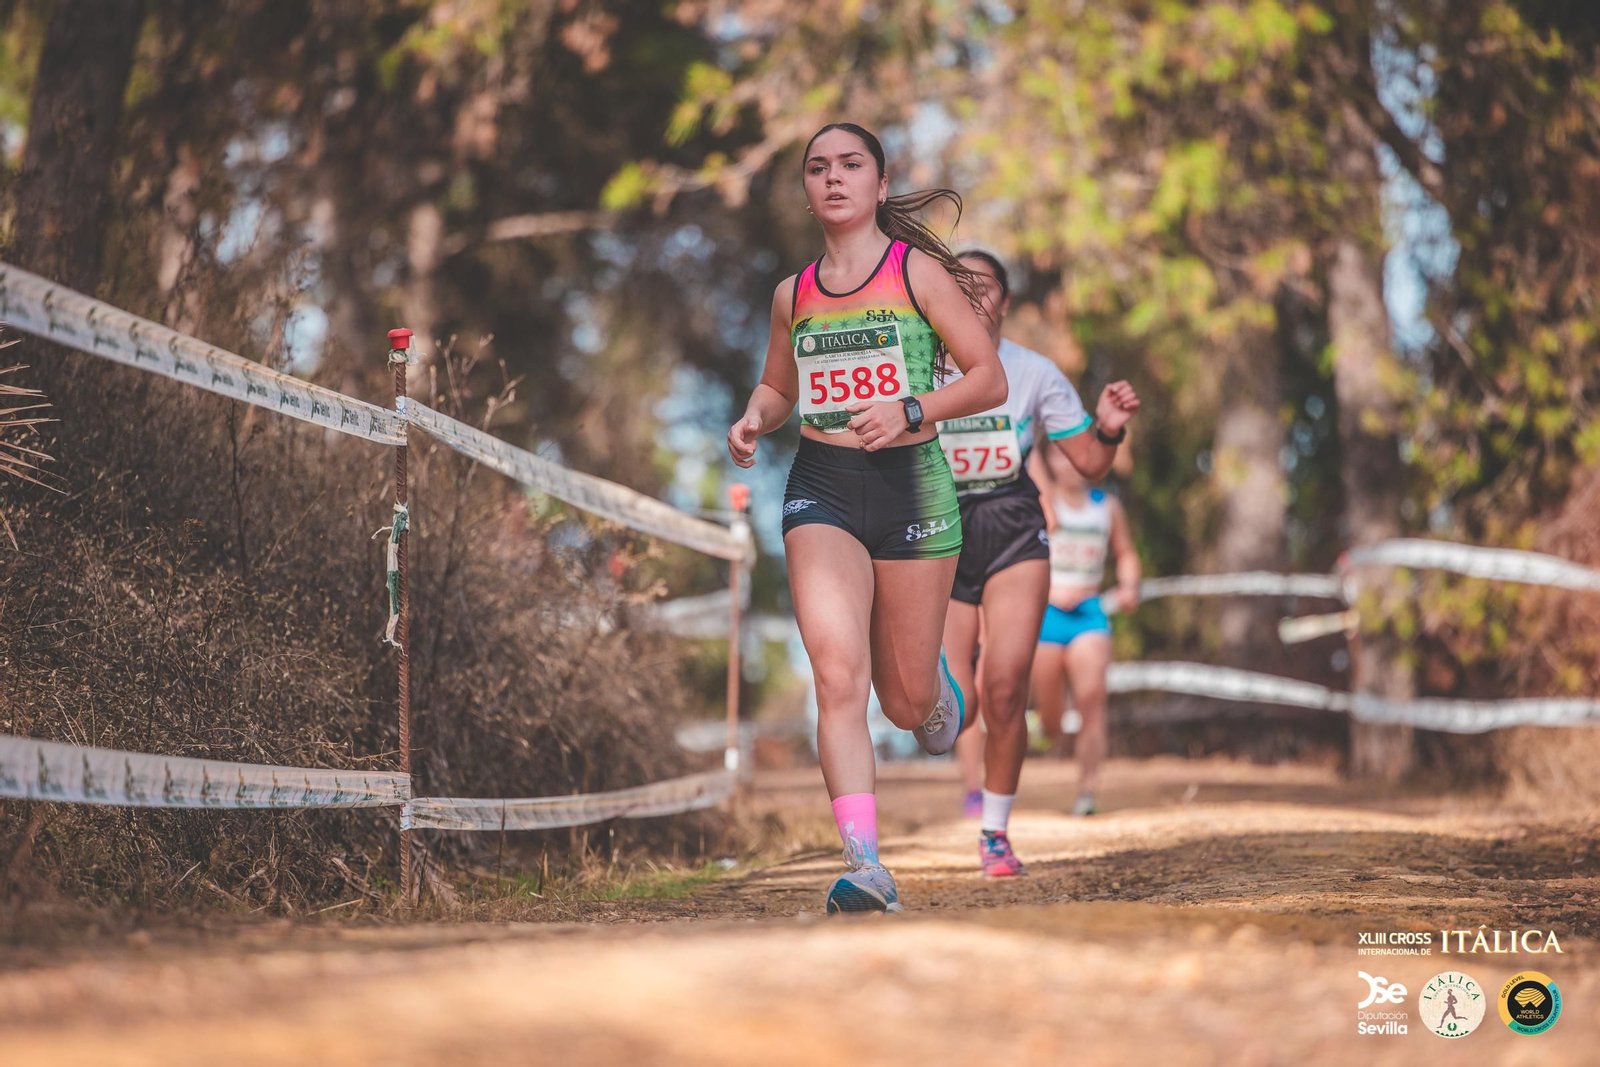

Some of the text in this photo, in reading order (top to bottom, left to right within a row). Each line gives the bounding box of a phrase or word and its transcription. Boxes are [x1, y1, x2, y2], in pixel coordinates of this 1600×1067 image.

[866, 309, 901, 323] SJA
[821, 333, 870, 348] ITÁLICA
[809, 362, 901, 405] 5588
[942, 445, 1012, 475] 575
